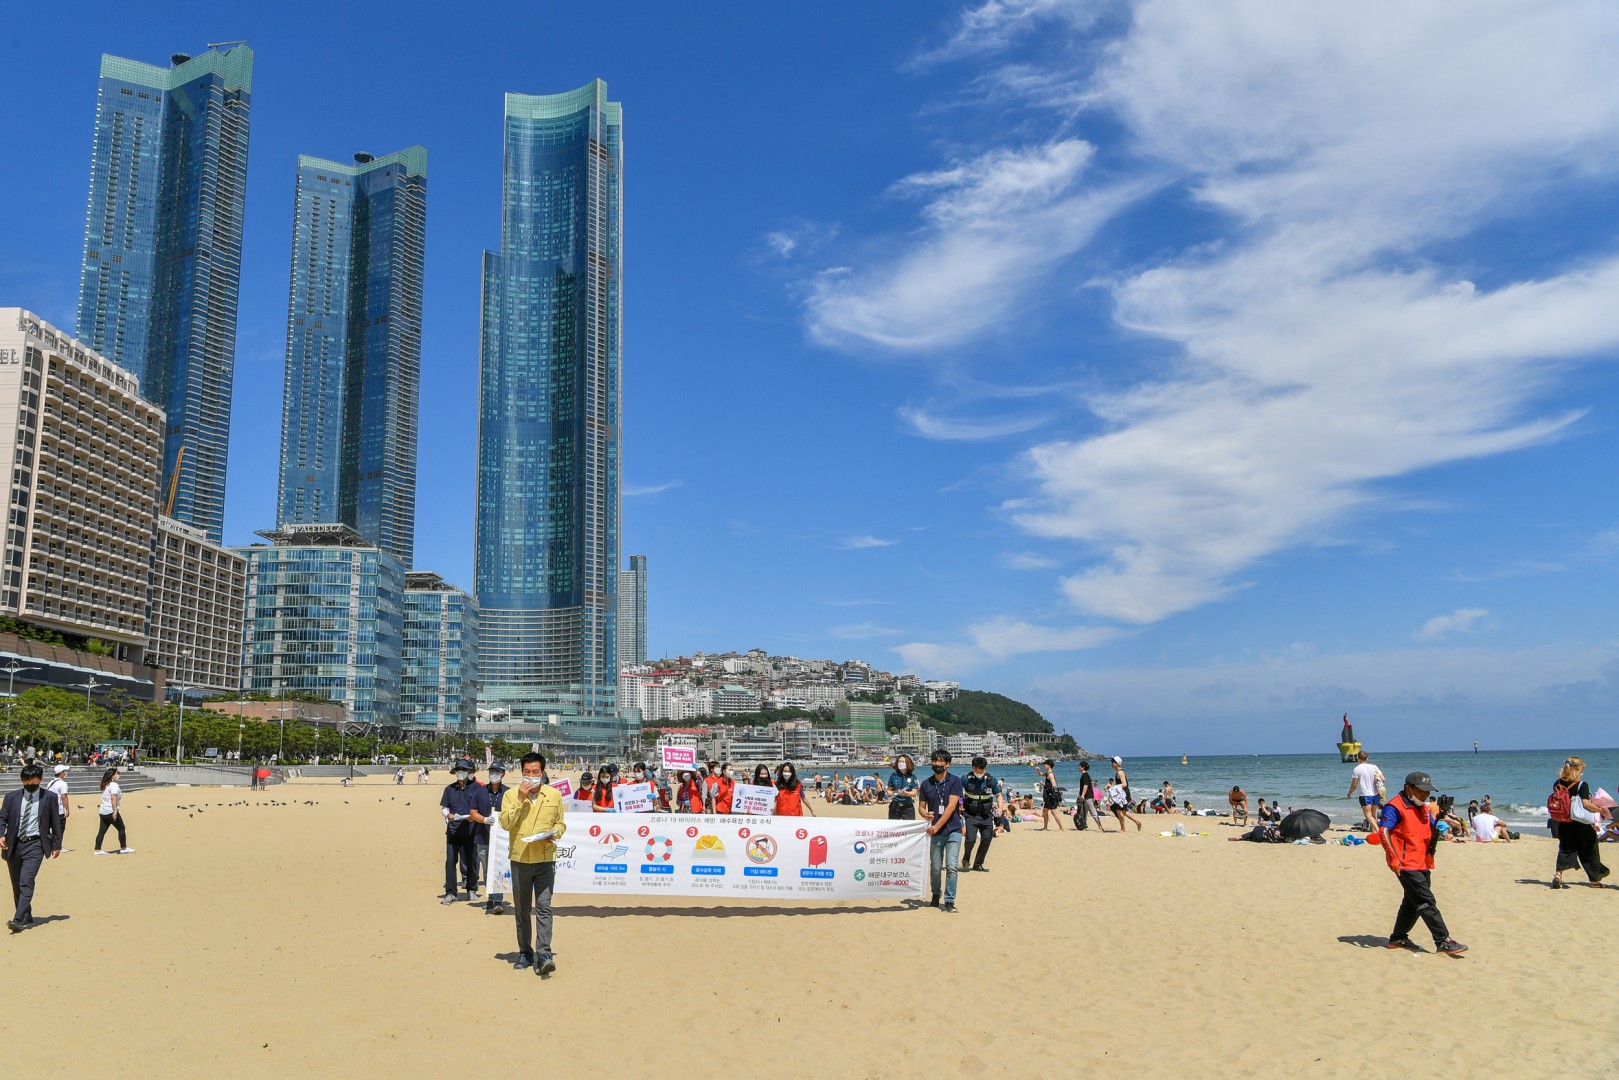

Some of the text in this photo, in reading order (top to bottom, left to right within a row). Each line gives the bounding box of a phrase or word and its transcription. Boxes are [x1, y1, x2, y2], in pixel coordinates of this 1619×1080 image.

[295, 525, 344, 533] PALEDECZ
[666, 751, 672, 760] 3
[618, 801, 622, 811] 1
[735, 798, 742, 809] 2
[678, 816, 702, 824] 바이러스
[719, 817, 744, 825] 해수욕장
[641, 828, 647, 836] 2
[689, 828, 696, 837] 3
[741, 829, 748, 837] 4
[798, 830, 805, 838] 5
[869, 857, 906, 865] 콜센터 1339
[867, 871, 911, 879] 해운대구보건소
